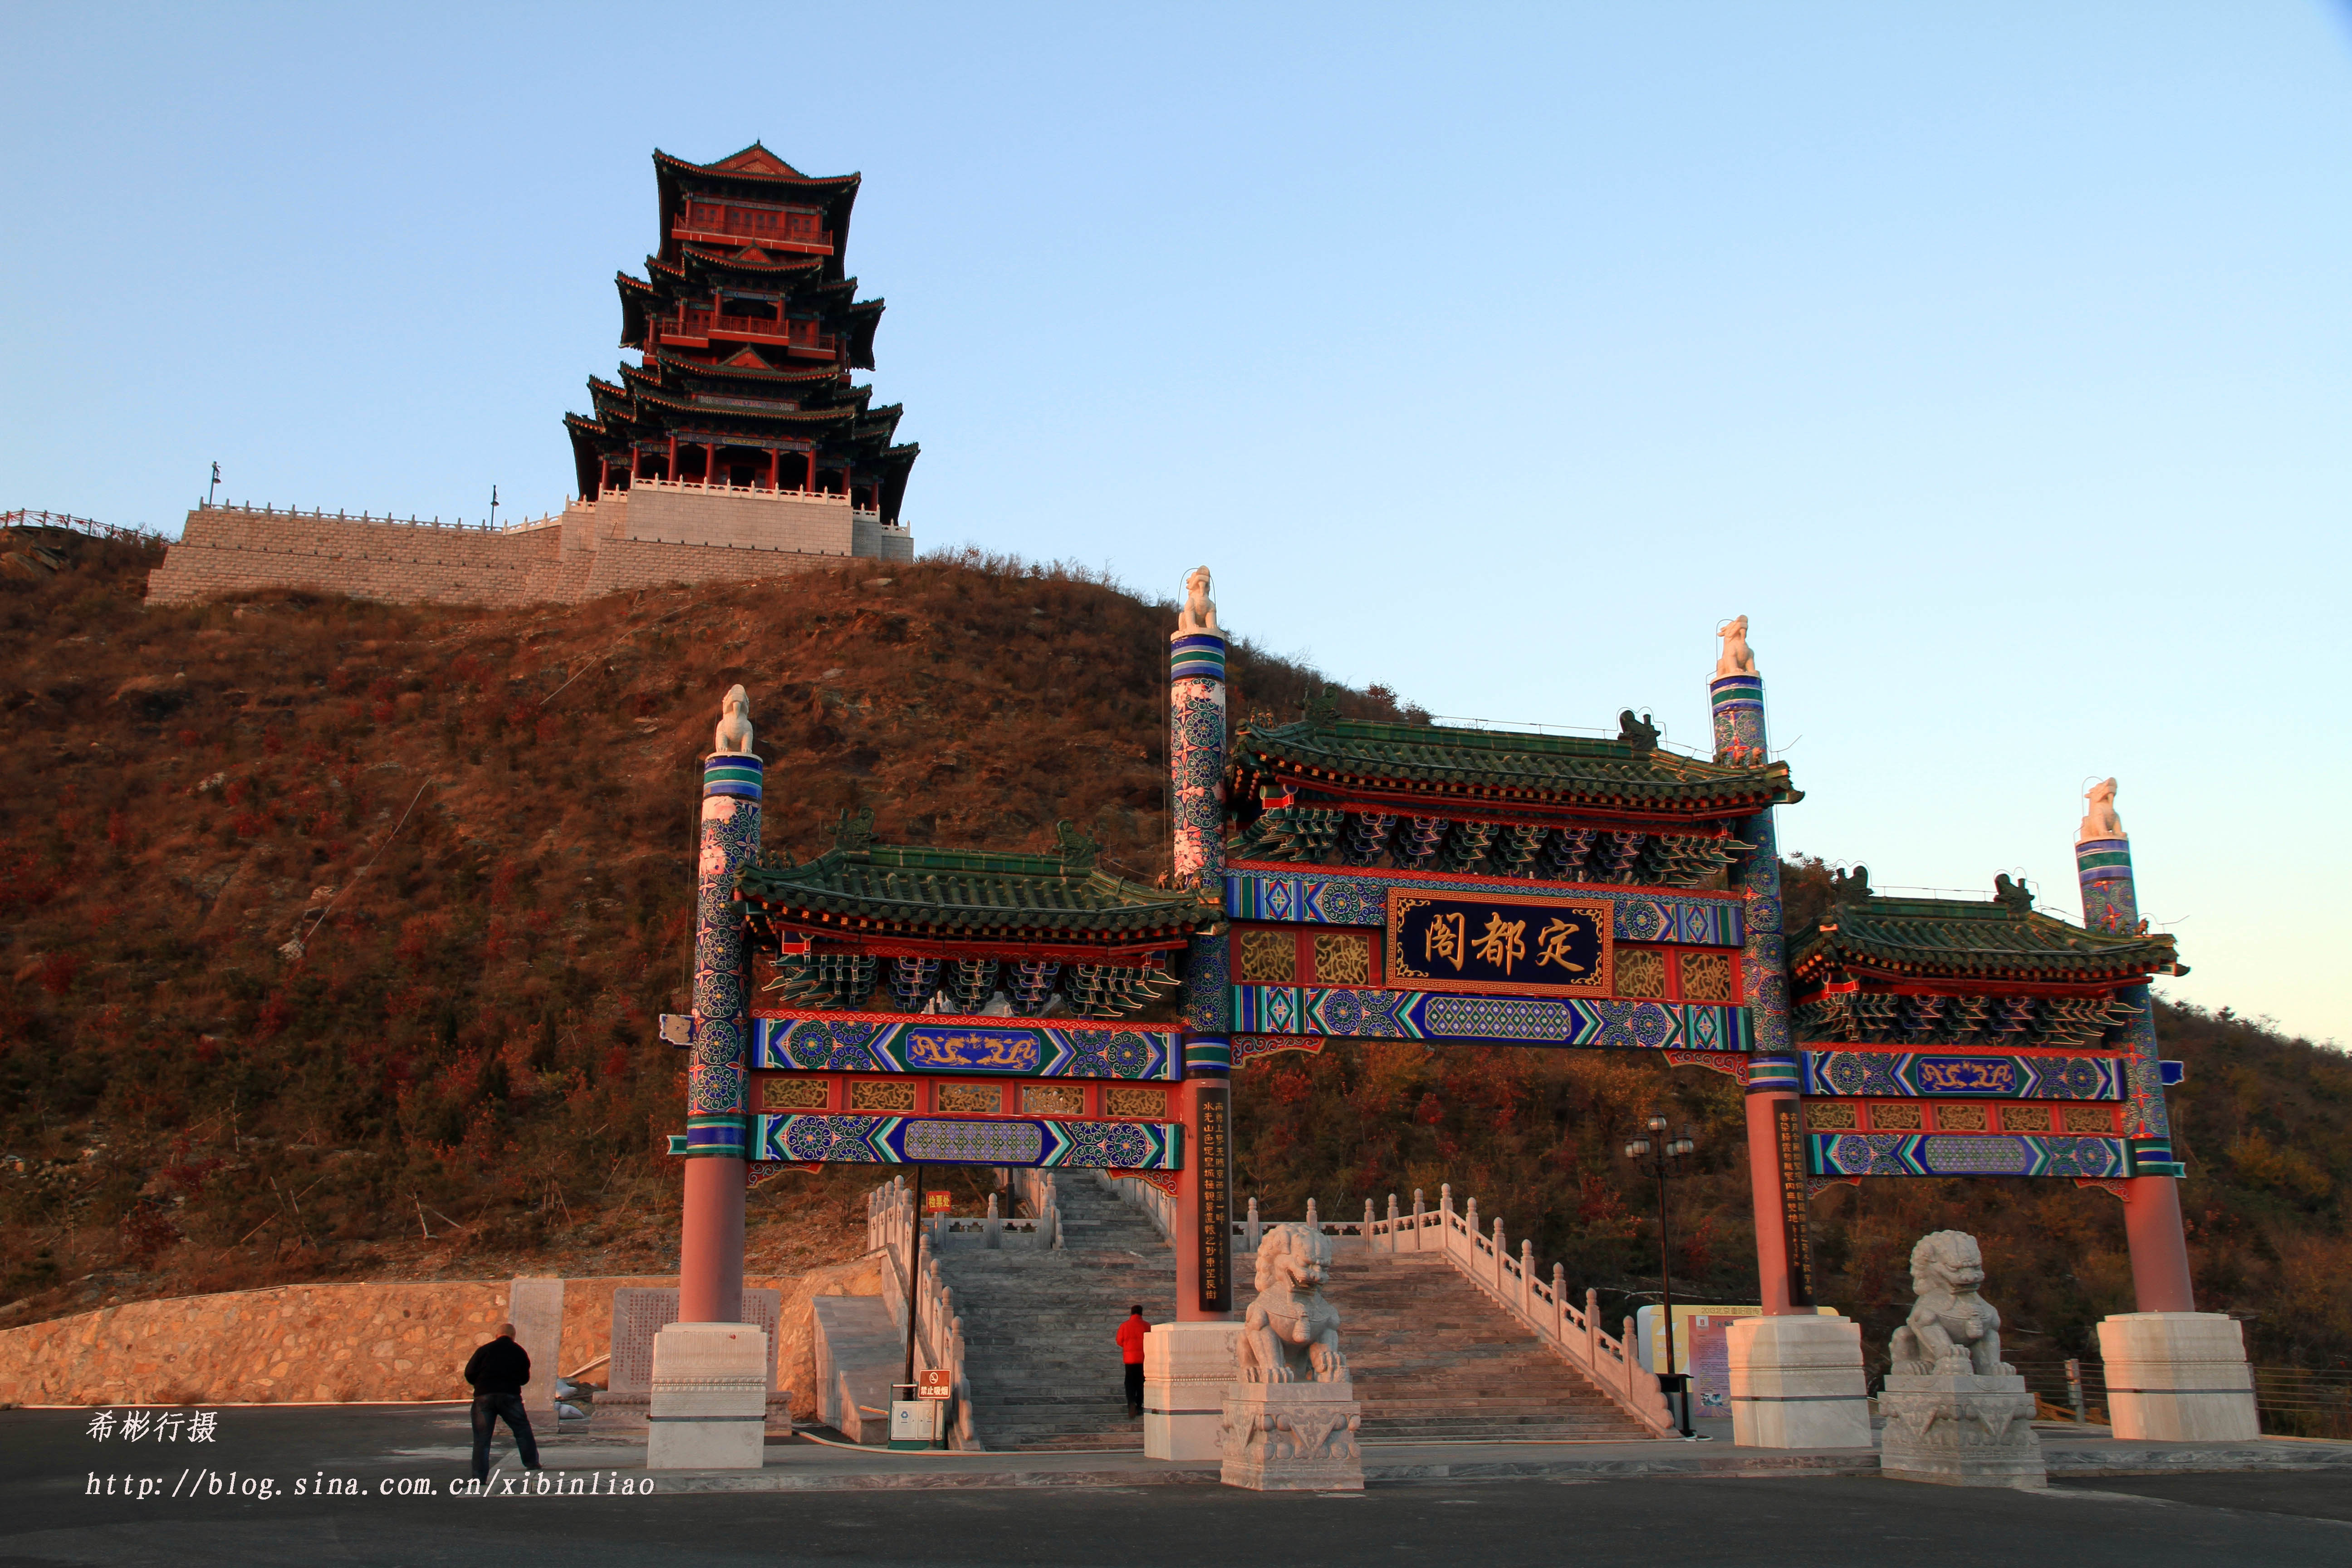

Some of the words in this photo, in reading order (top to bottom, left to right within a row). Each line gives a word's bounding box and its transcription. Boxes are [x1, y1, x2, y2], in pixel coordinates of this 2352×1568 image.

[928, 1195, 950, 1208] 检票处
[920, 1386, 949, 1396] 禁止吸烟
